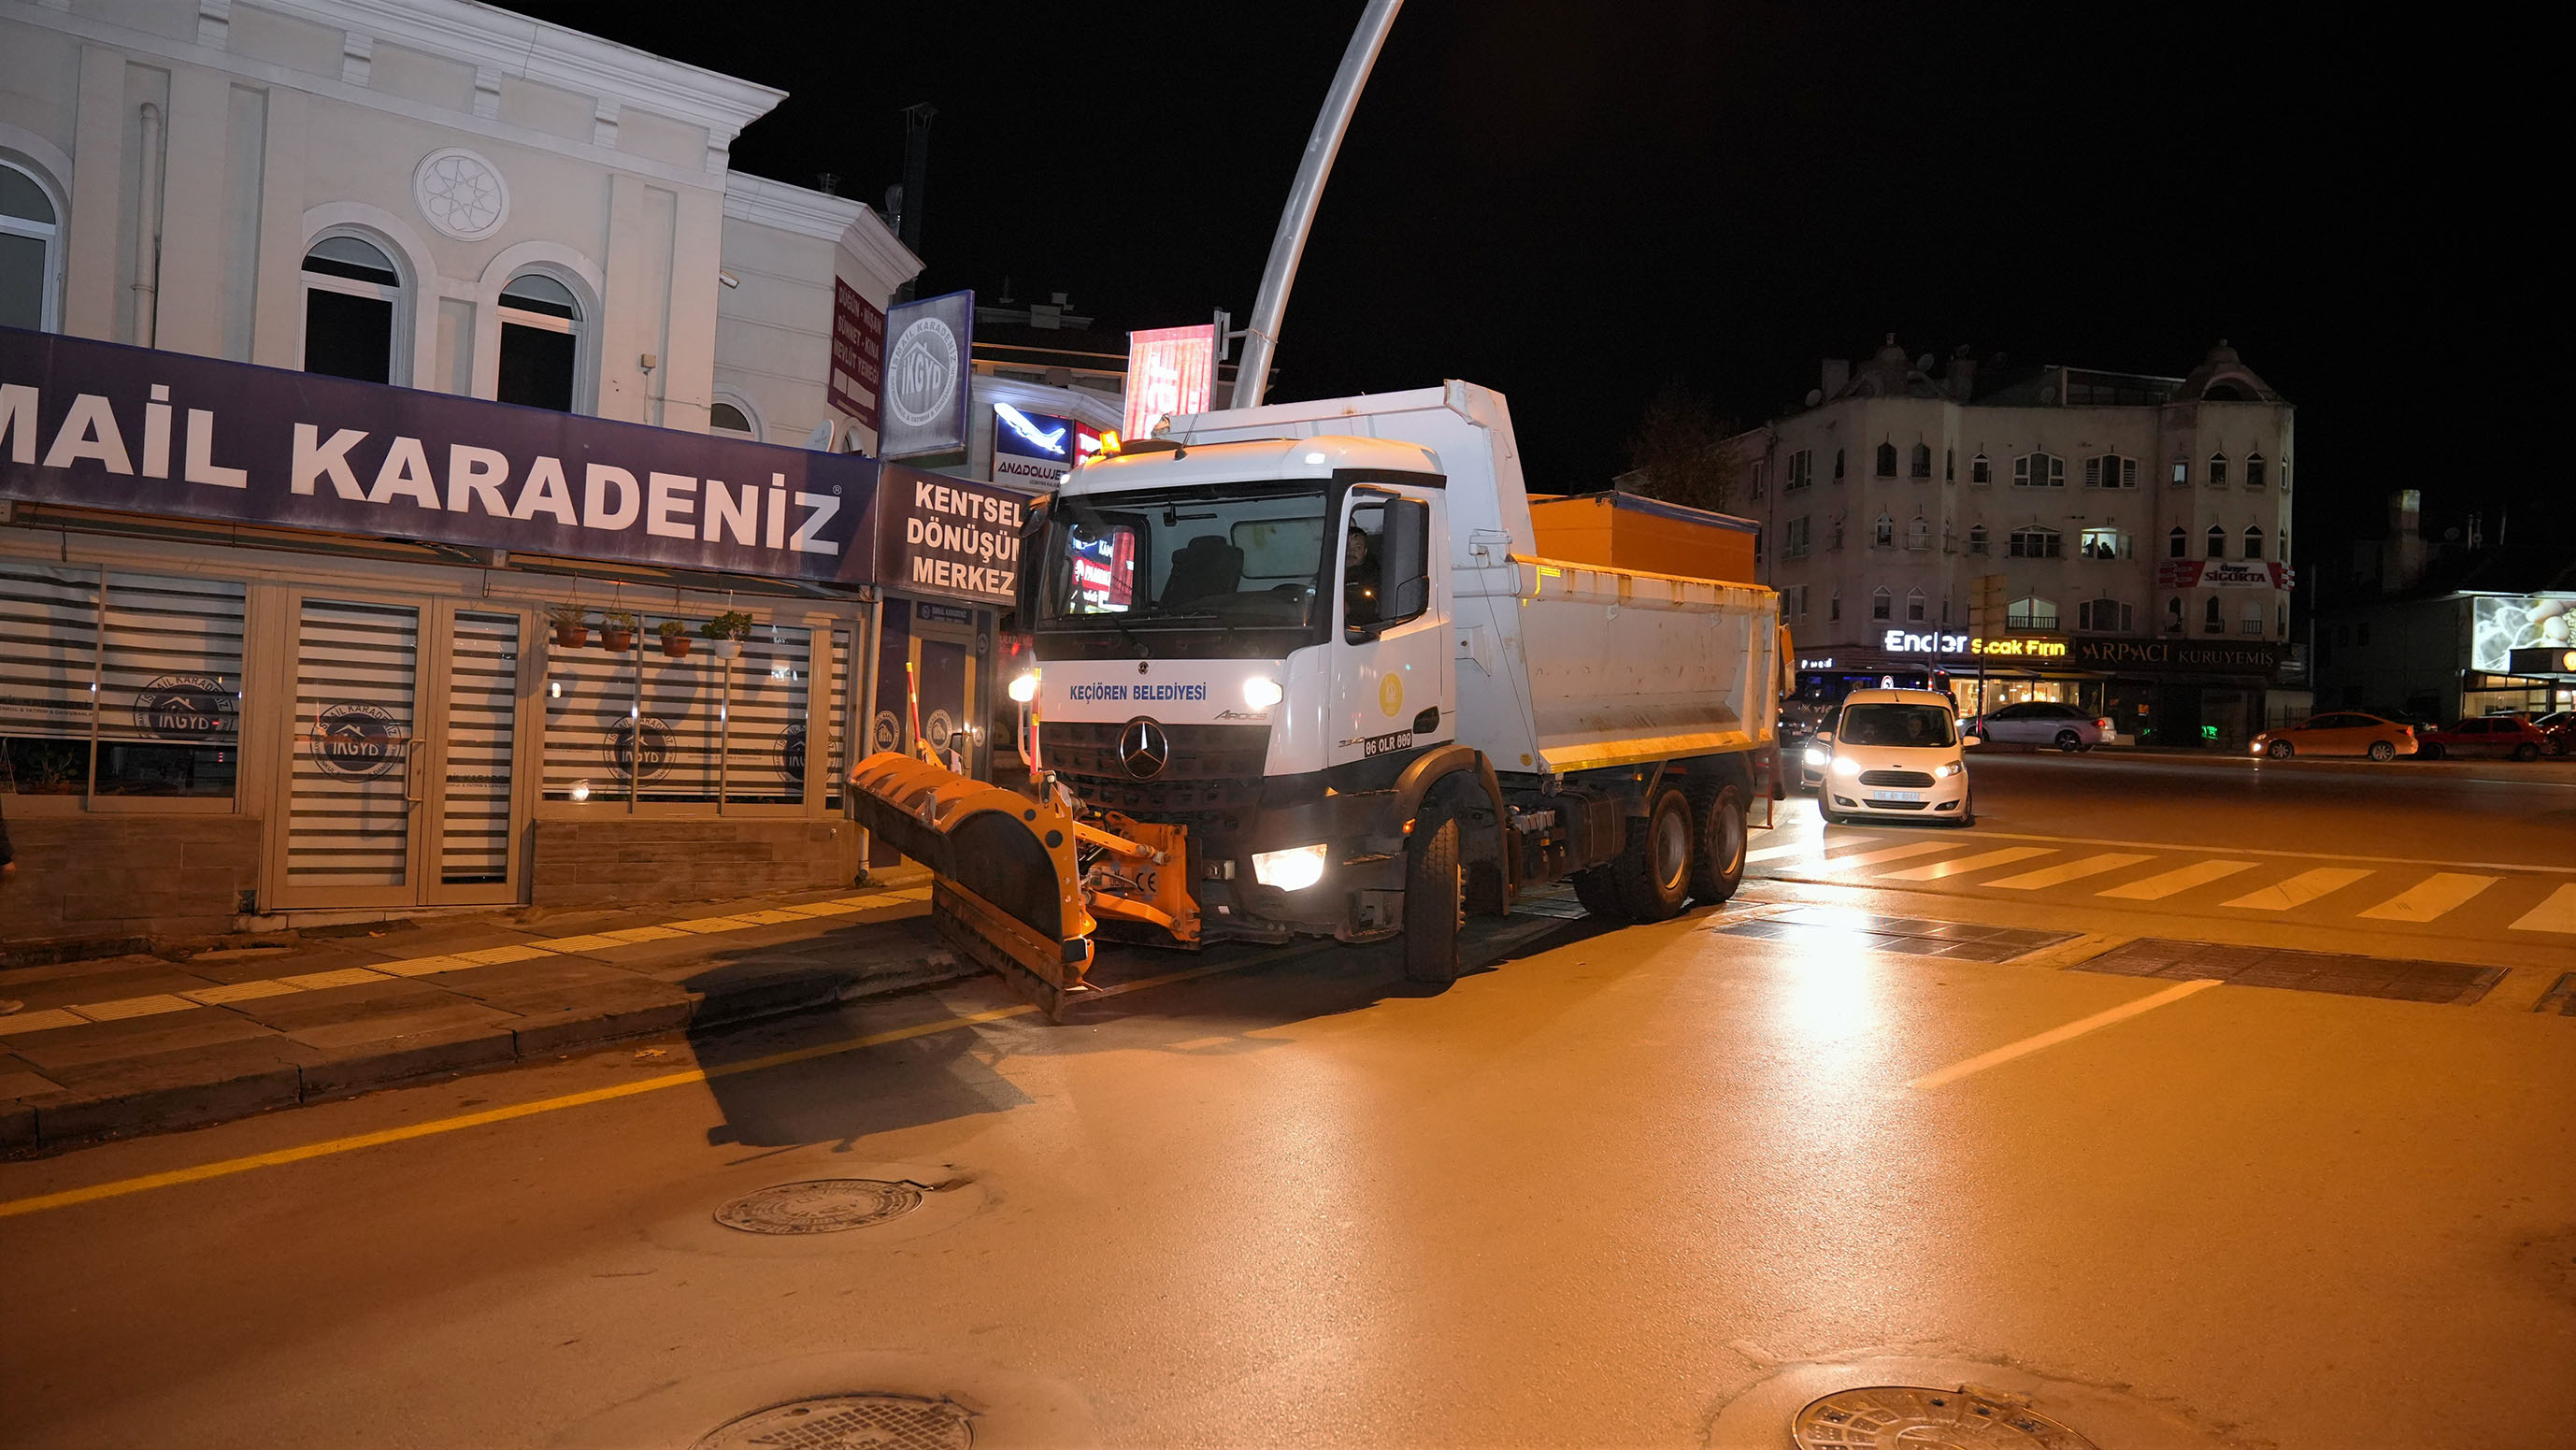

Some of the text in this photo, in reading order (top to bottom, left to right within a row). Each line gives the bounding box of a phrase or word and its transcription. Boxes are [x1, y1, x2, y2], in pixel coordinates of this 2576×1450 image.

[917, 322, 956, 363] KARADENİZ
[291, 423, 840, 555] KARADENİZ
[915, 481, 1023, 528] KENTSEL
[912, 556, 1015, 596] MERKEZ
[1971, 639, 2023, 654] Scak
[2082, 642, 2273, 667] ARPACI KURUYEMİŞ
[1070, 682, 1207, 704] KEÇİÖREN BELEDİYESİ
[1379, 736, 1395, 753] OLR
[1136, 872, 1157, 893] CE
